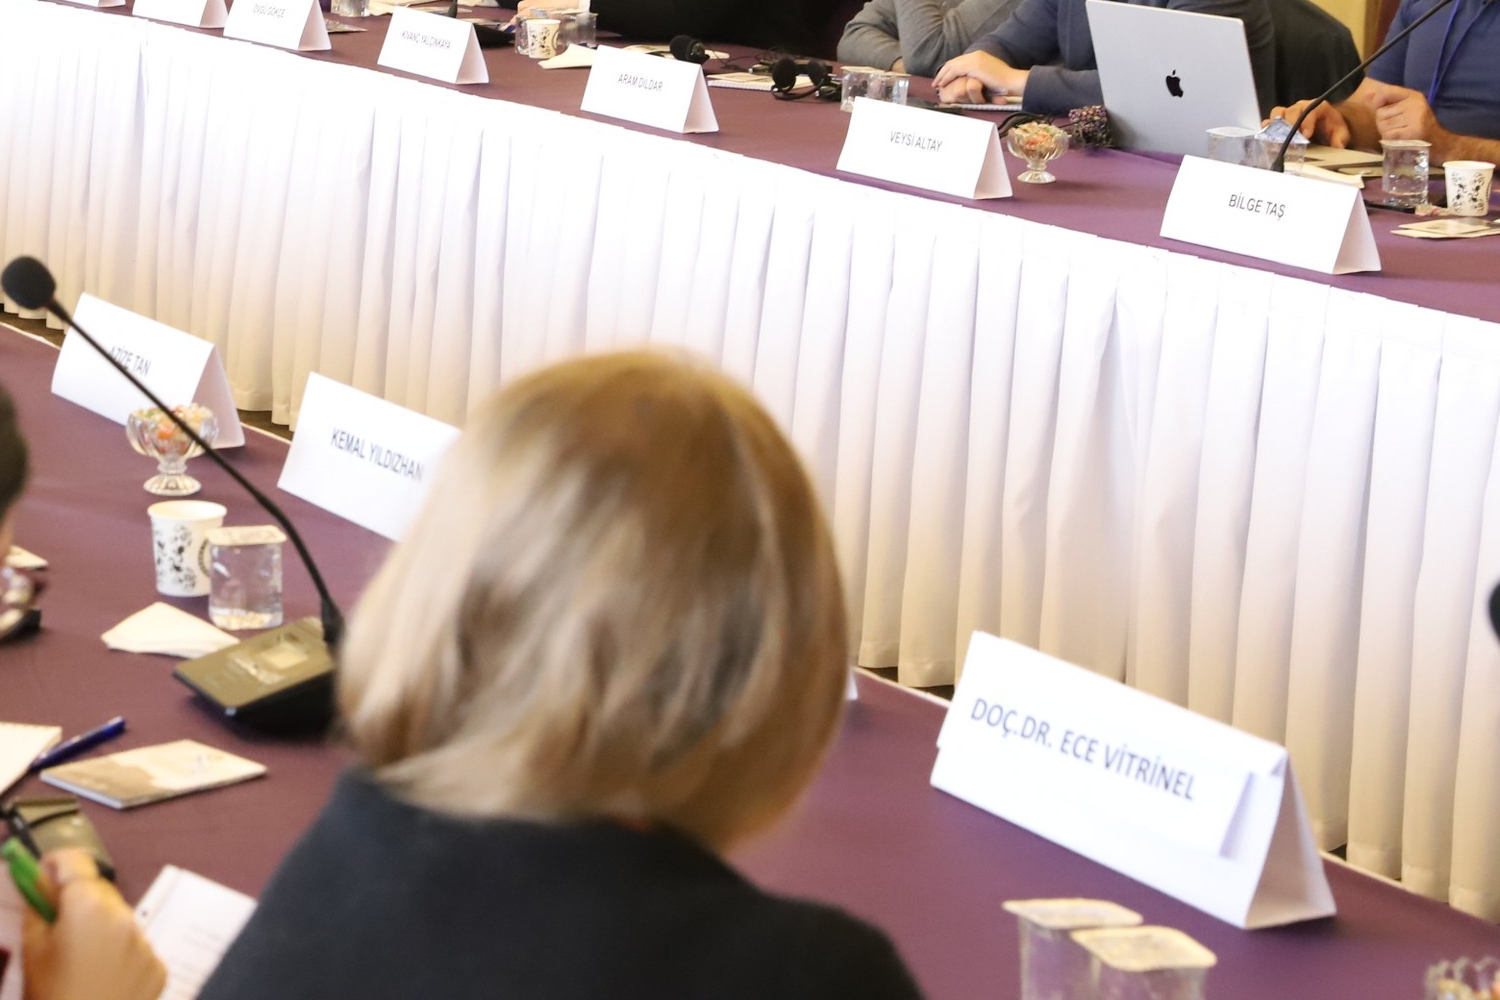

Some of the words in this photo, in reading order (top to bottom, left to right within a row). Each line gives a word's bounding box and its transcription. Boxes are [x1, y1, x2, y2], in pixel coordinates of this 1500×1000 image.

[618, 73, 638, 86] ARAM
[915, 136, 943, 152] ALTAY
[1228, 192, 1263, 213] BİLGE
[1265, 201, 1286, 221] TAŞ
[132, 355, 152, 377] TAN
[330, 427, 365, 459] KEMAL
[368, 442, 424, 483] YILDIZHAN
[970, 698, 1052, 748] DOÇ.DR.
[1060, 730, 1099, 764] ECE
[1104, 743, 1194, 801] VİTRİNEL
